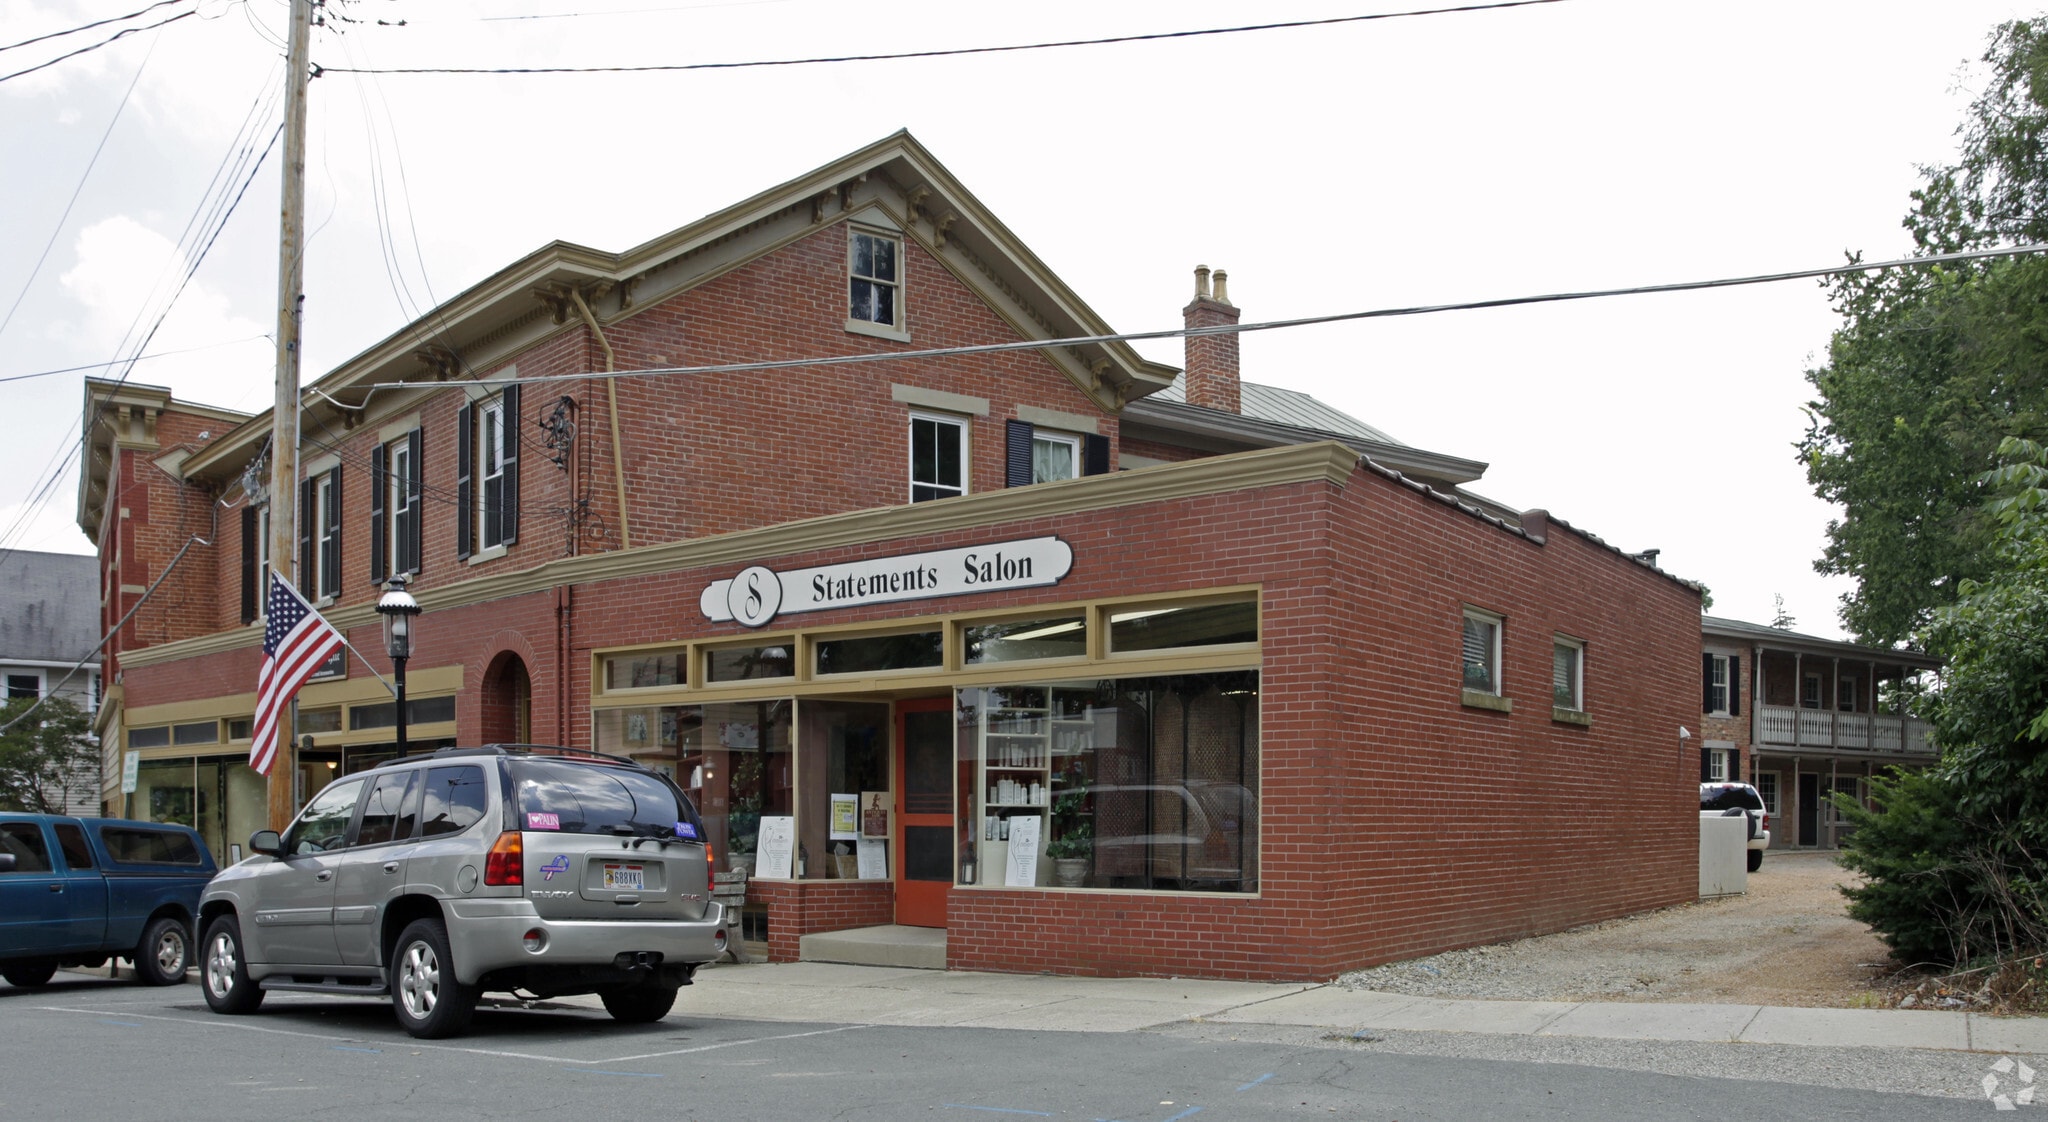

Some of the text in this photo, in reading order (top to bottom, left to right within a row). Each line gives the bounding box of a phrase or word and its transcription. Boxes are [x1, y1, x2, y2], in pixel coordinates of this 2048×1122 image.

[812, 563, 938, 602] Statements
[964, 551, 1033, 585] Salon
[538, 813, 560, 826] PALIN
